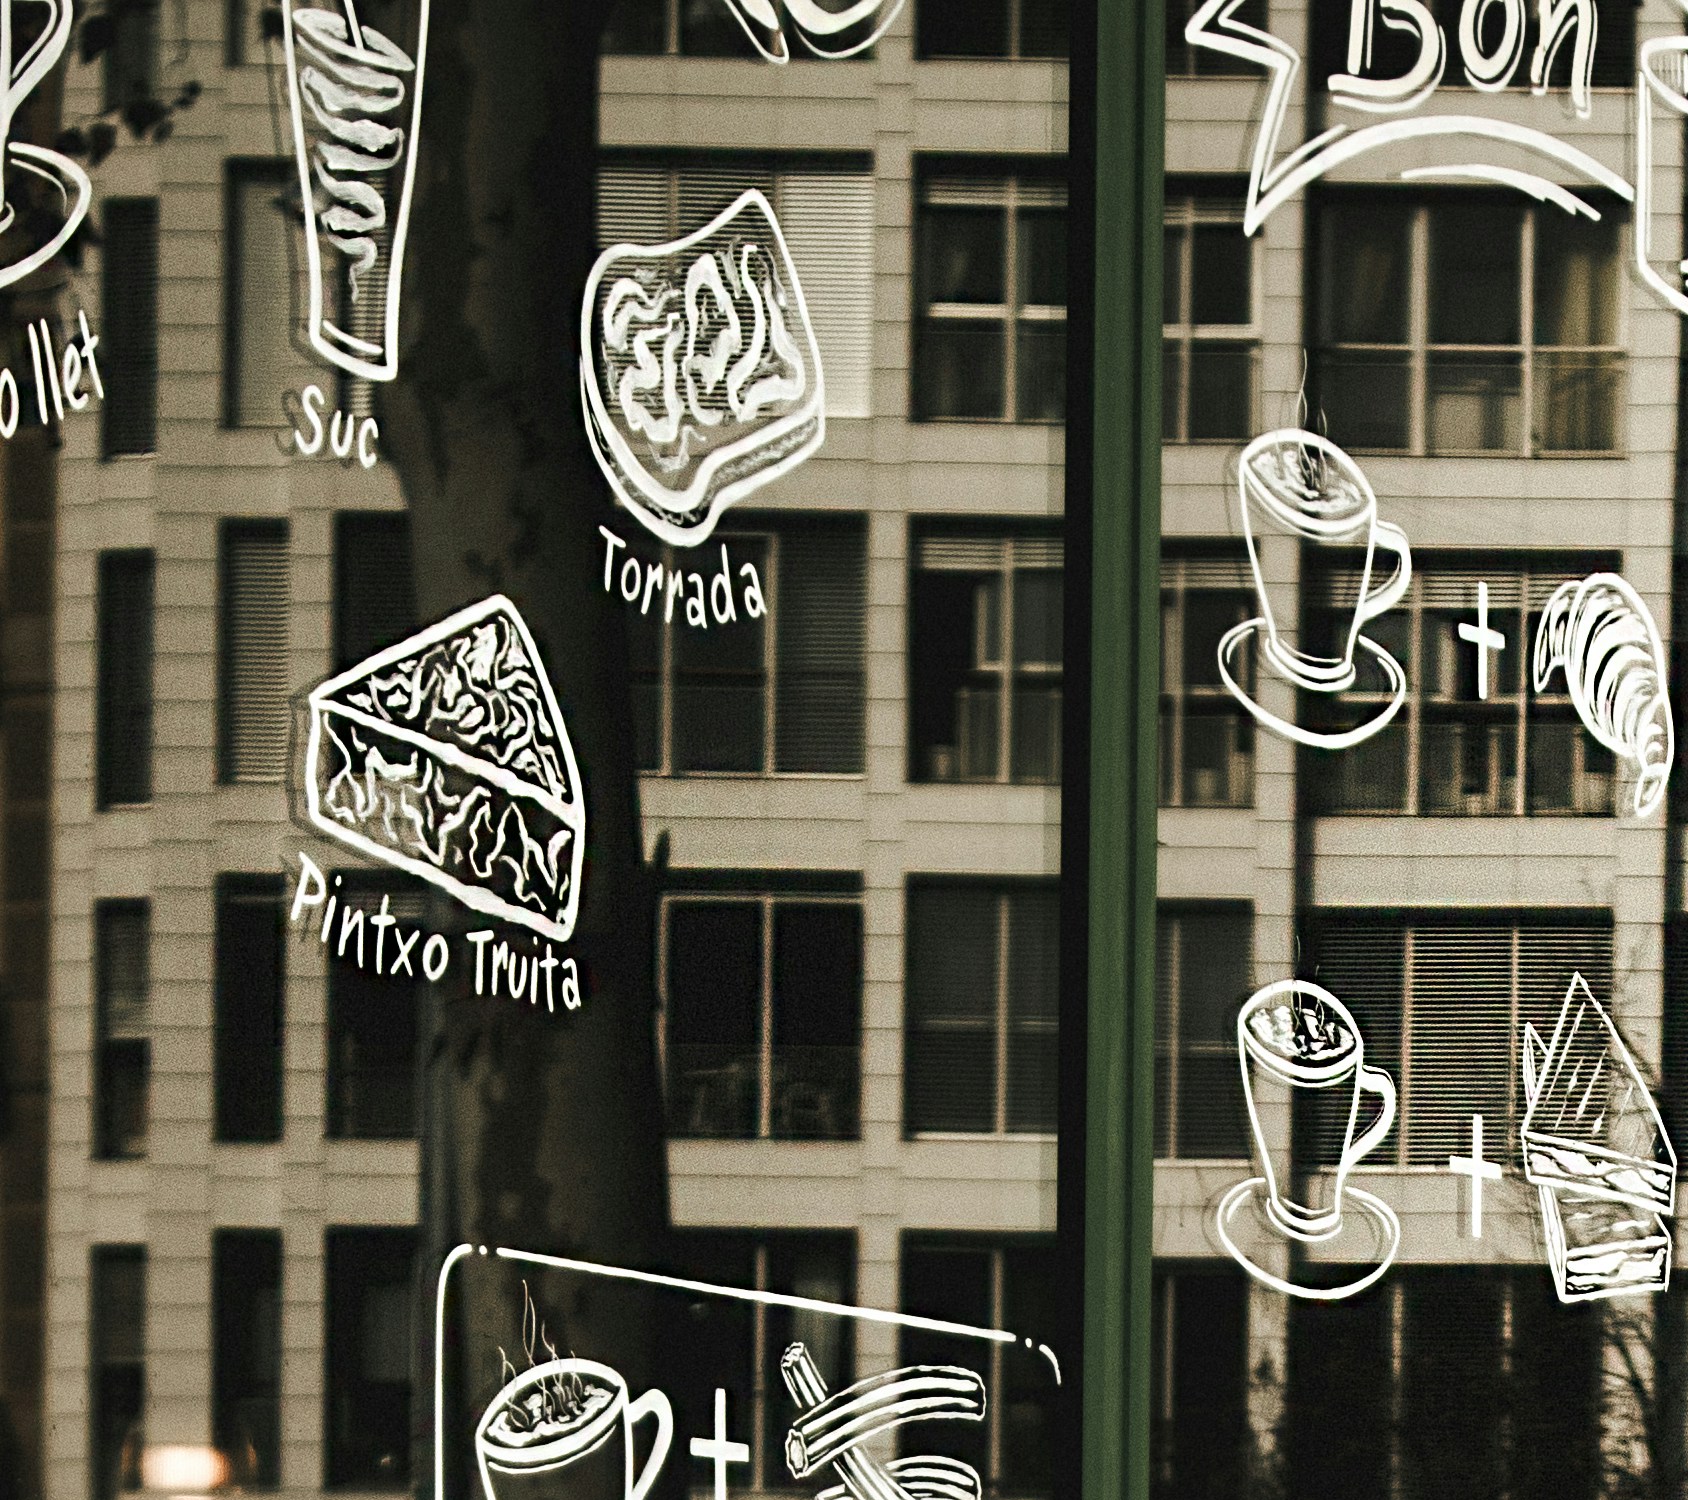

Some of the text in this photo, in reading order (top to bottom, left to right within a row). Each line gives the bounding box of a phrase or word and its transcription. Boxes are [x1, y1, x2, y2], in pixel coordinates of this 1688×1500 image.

[27, 309, 104, 425] llet
[292, 385, 379, 468] Suc
[597, 526, 766, 628] Torrada
[290, 851, 581, 1012] Pintxo Truita
